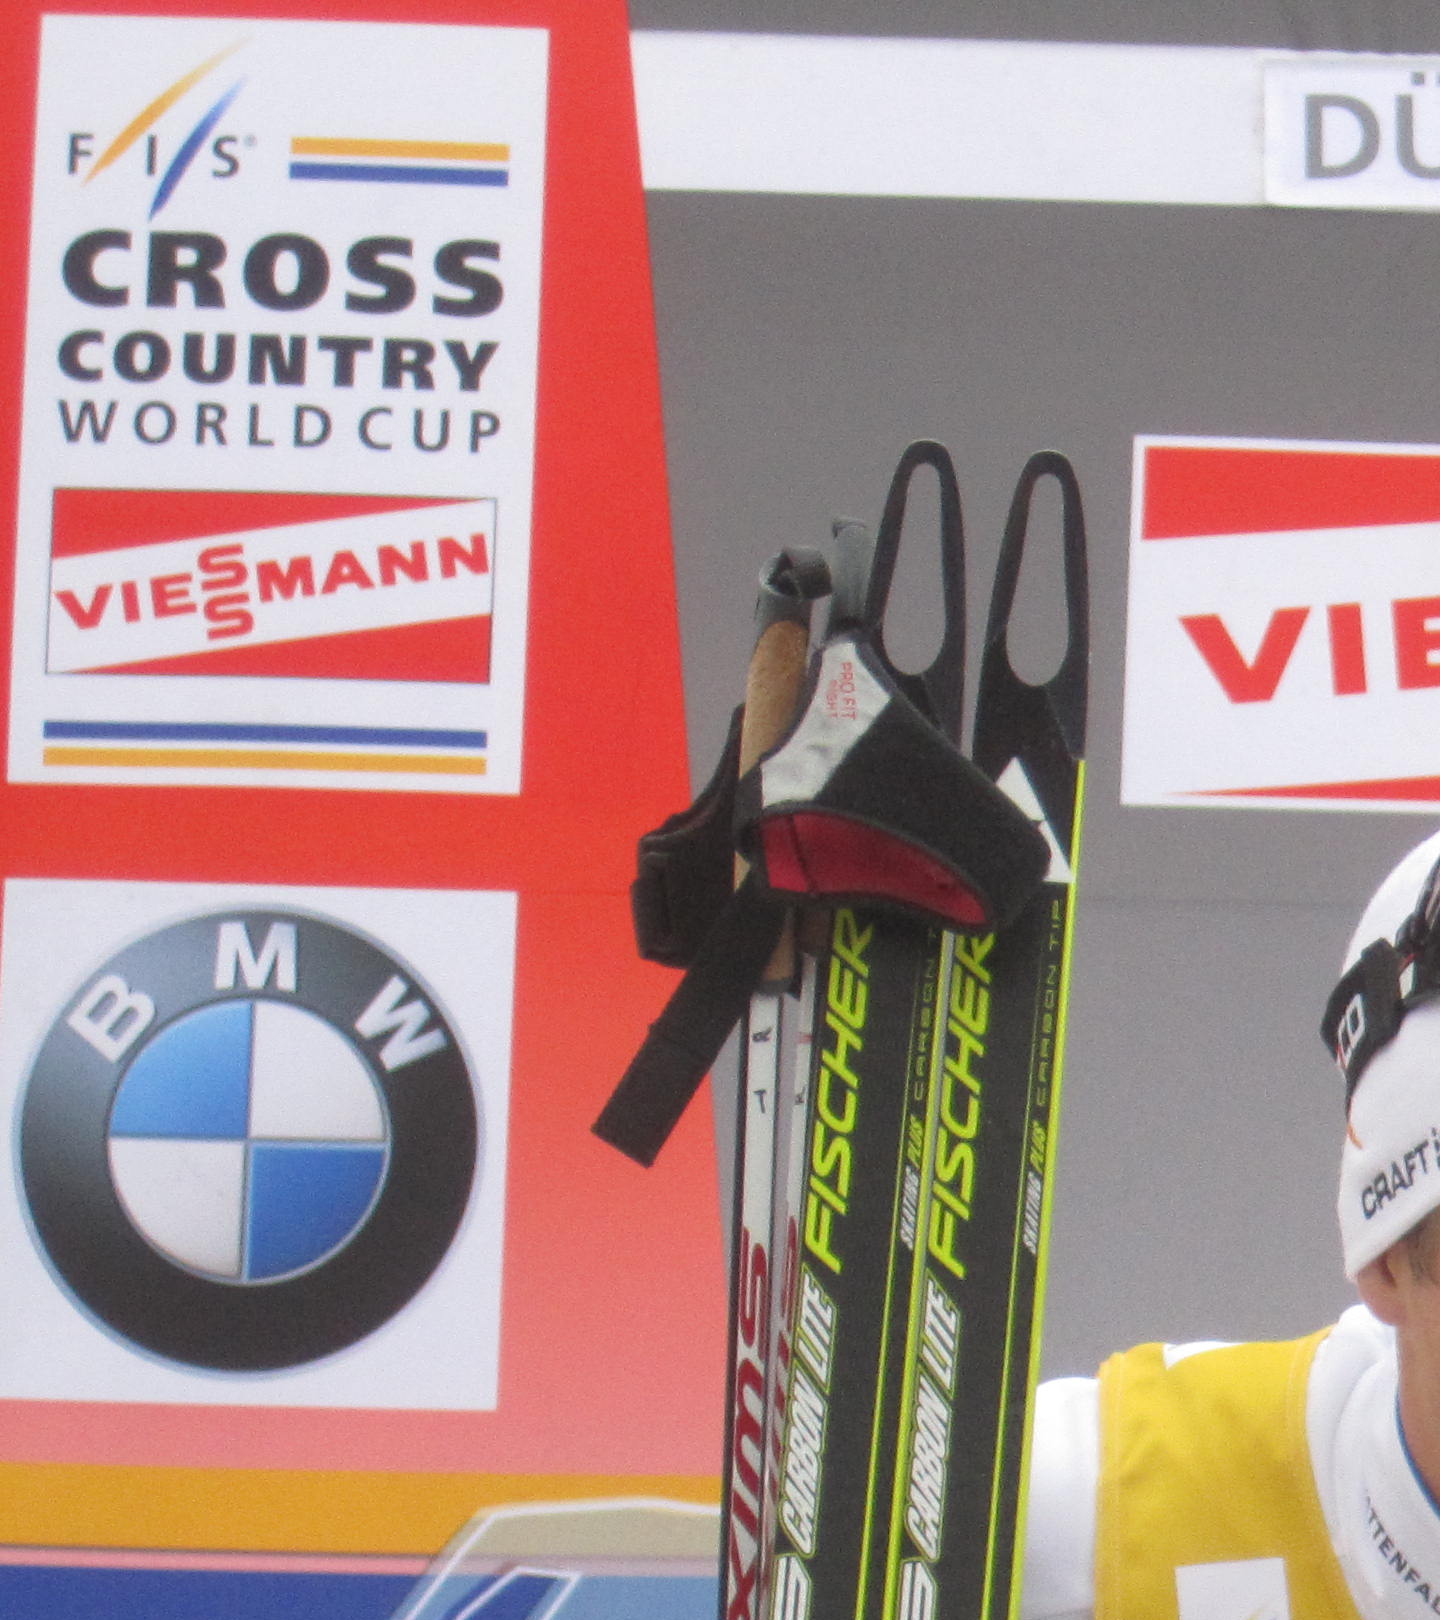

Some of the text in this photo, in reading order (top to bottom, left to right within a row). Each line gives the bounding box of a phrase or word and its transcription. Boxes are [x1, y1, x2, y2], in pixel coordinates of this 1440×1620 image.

[67, 132, 242, 178] FIS
[61, 229, 504, 317] CROSS
[57, 330, 500, 392] COUNTRY
[57, 399, 501, 453] WORLD CUP
[54, 532, 489, 641] VIESSMANN
[67, 921, 447, 1072] BMW
[804, 908, 874, 1275] FISCHER
[907, 1114, 925, 1168] PLUS
[928, 932, 997, 1281] FISCHER
[1030, 1119, 1049, 1174] PLUS
[1360, 1140, 1433, 1220] CRAFT
[797, 1272, 835, 1396] LITE
[919, 1276, 958, 1399] LITE
[781, 1372, 826, 1556] CARBON
[905, 1377, 951, 1562] CARBON
